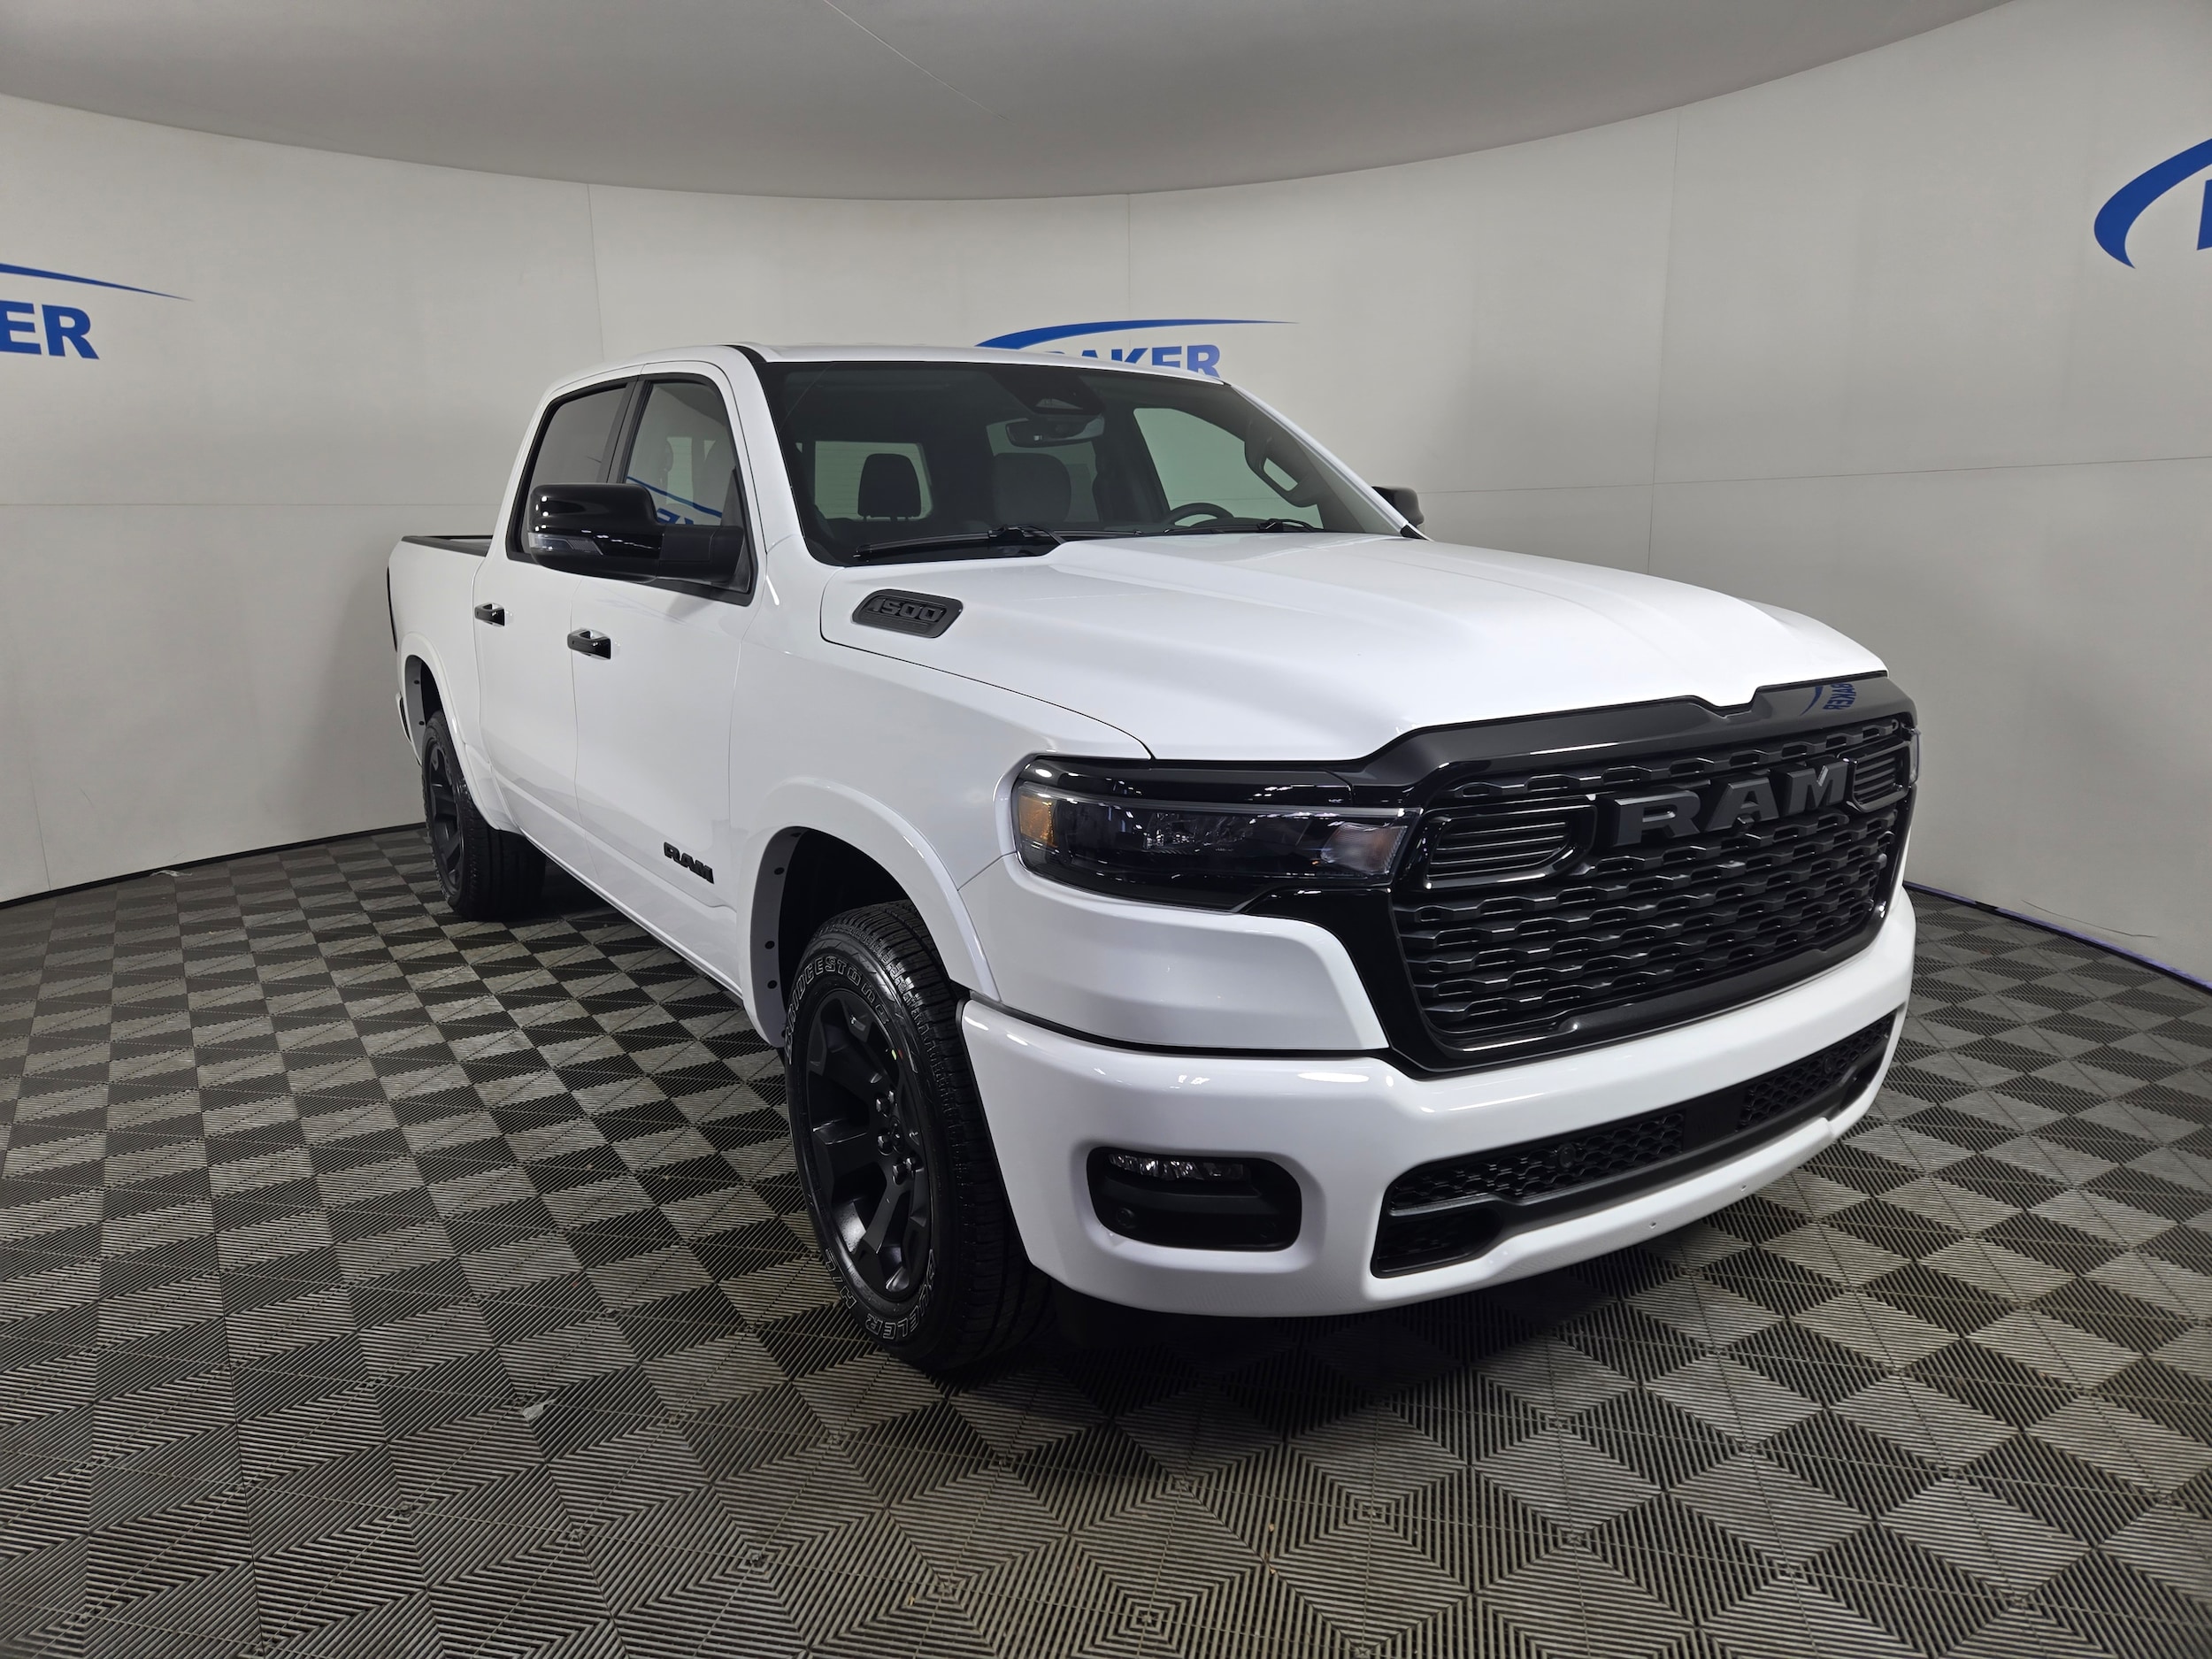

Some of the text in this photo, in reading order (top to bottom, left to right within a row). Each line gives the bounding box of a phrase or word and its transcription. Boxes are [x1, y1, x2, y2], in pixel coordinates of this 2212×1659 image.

[865, 596, 943, 622] 1500
[1613, 760, 1849, 847] RAM
[664, 841, 714, 885] RAM
